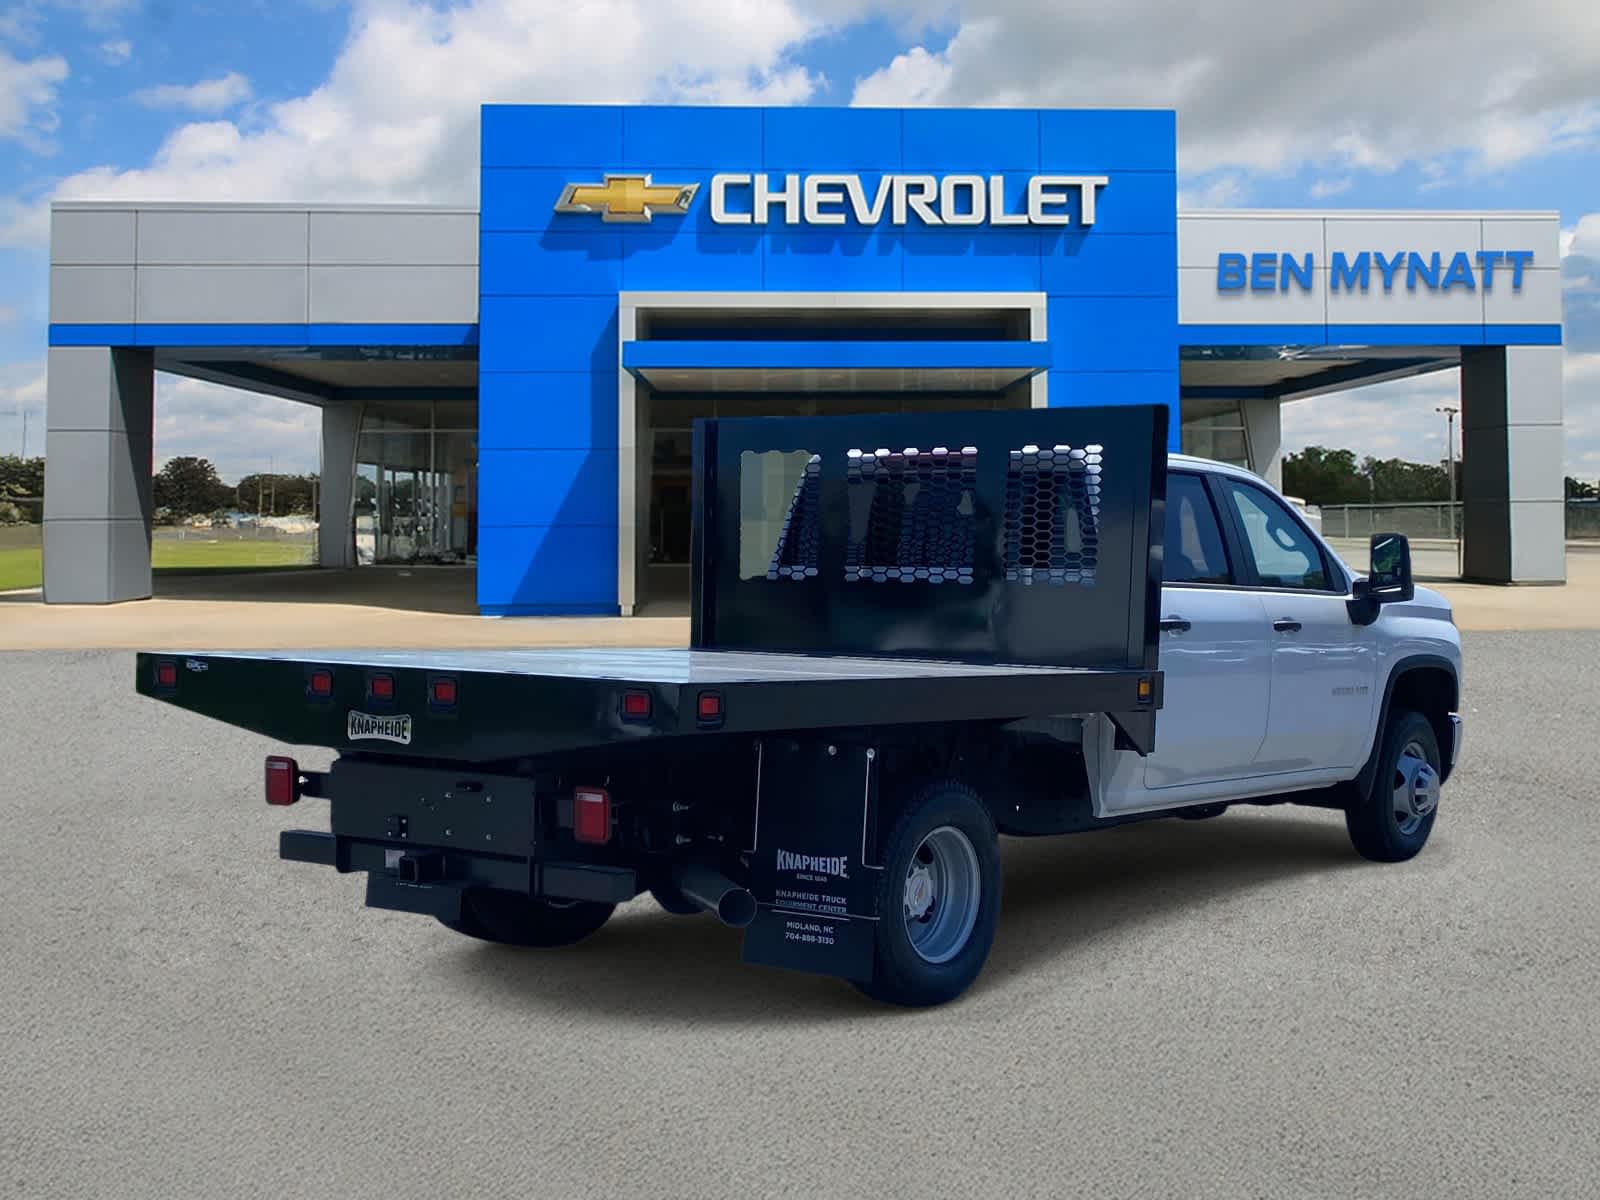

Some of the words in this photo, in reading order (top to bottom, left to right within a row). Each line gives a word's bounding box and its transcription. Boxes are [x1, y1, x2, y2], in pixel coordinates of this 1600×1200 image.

[710, 173, 1110, 225] CHEVROLET
[1217, 252, 1313, 291] BEN
[1330, 250, 1534, 291] MYNATT
[351, 716, 408, 739] KNAPHEIDE
[776, 848, 849, 879] KNAPHEIDE
[776, 889, 819, 902] KNAPHEIDE
[822, 894, 847, 905] TRUCK
[818, 904, 846, 913] CENTER
[786, 921, 822, 934] MIDLAND,
[823, 925, 835, 934] NC
